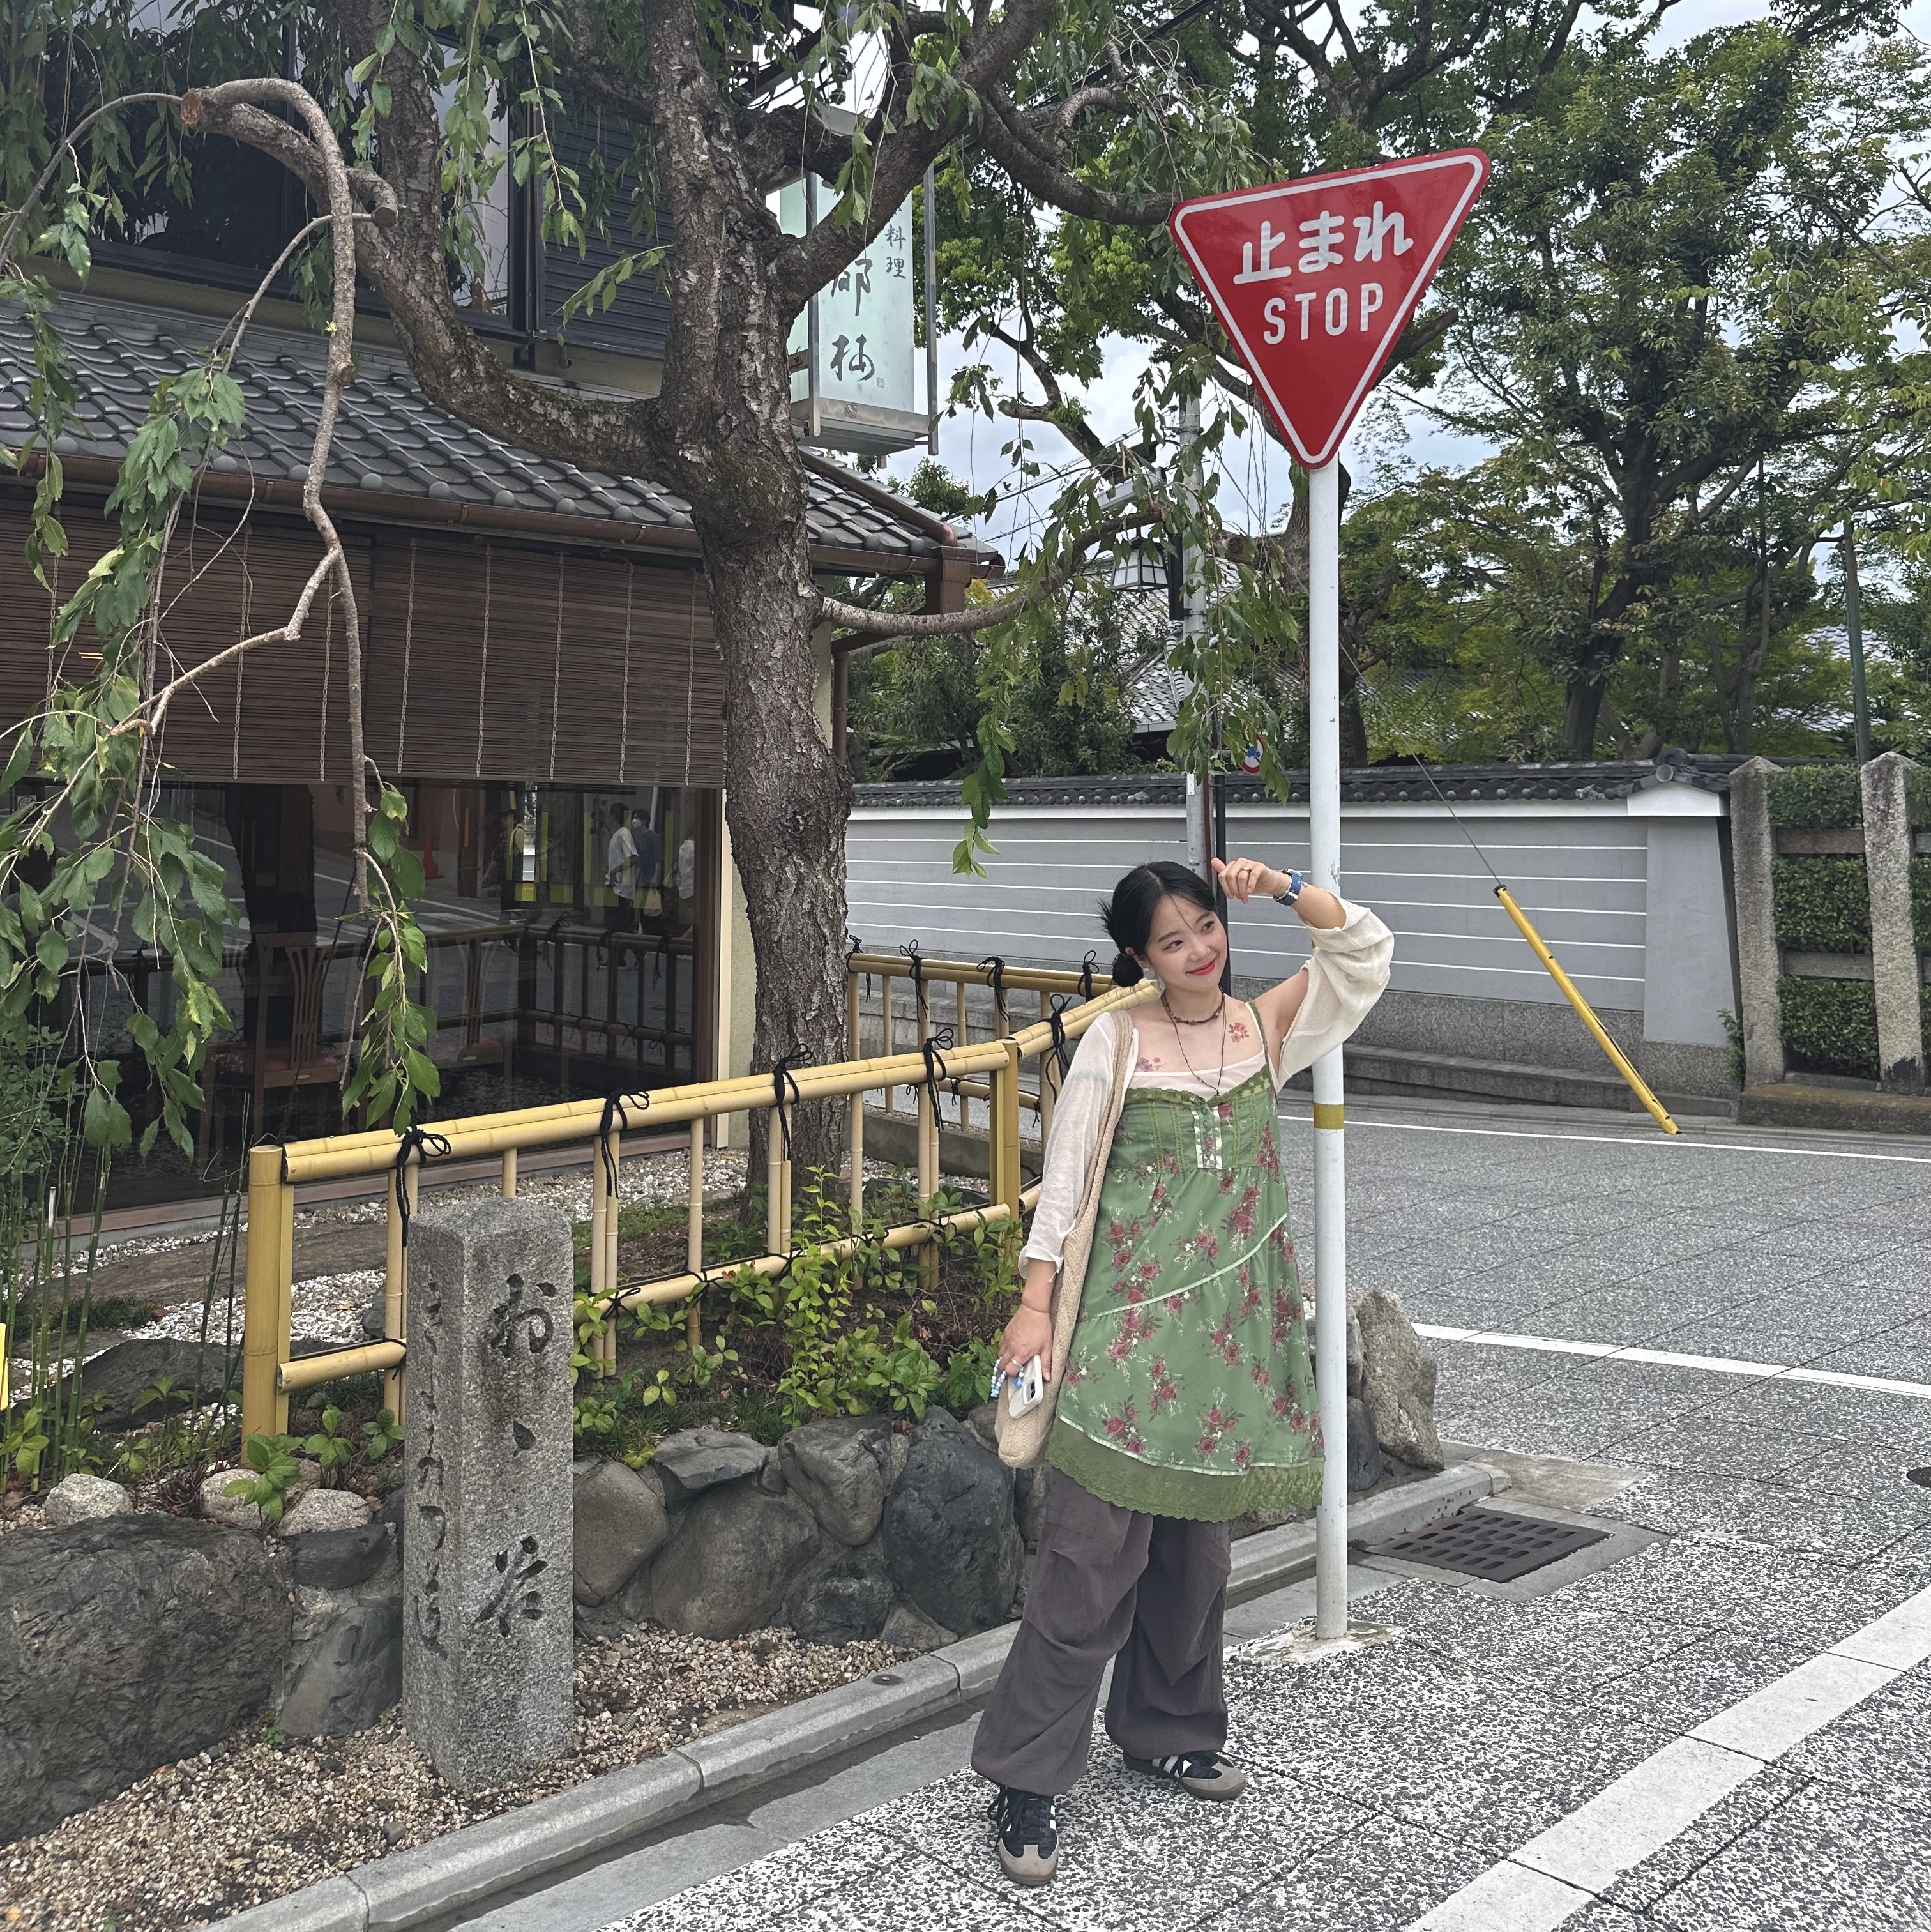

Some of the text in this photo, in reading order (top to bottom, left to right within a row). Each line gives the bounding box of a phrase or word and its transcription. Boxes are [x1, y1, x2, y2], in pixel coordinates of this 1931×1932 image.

[885, 208, 906, 279] 料理
[1233, 201, 1414, 285] 止まれ
[1263, 282, 1384, 345] STOP
